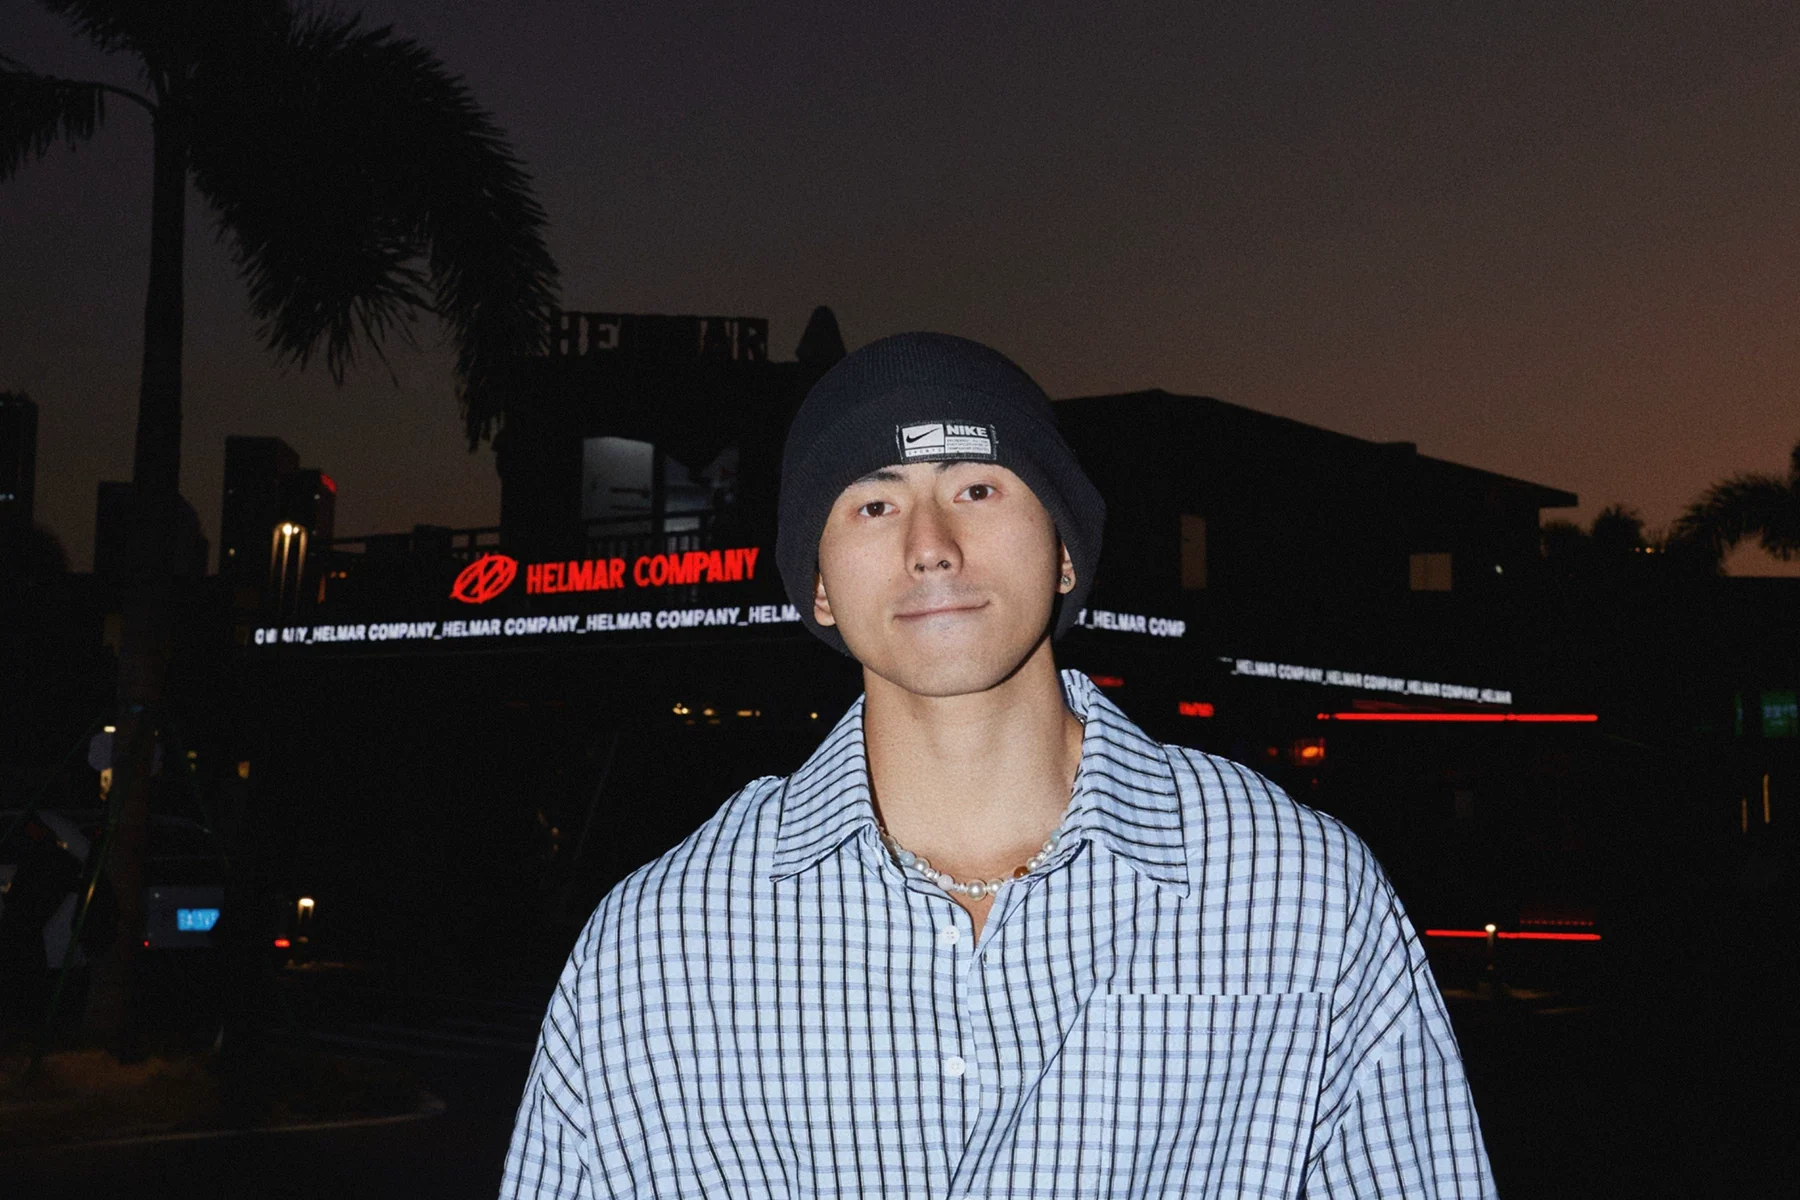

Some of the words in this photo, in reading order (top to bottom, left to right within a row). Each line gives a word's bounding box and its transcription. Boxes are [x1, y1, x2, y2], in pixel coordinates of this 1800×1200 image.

[946, 424, 988, 437] NIKE
[526, 556, 626, 594] HELMAR
[633, 547, 760, 587] COMPANY
